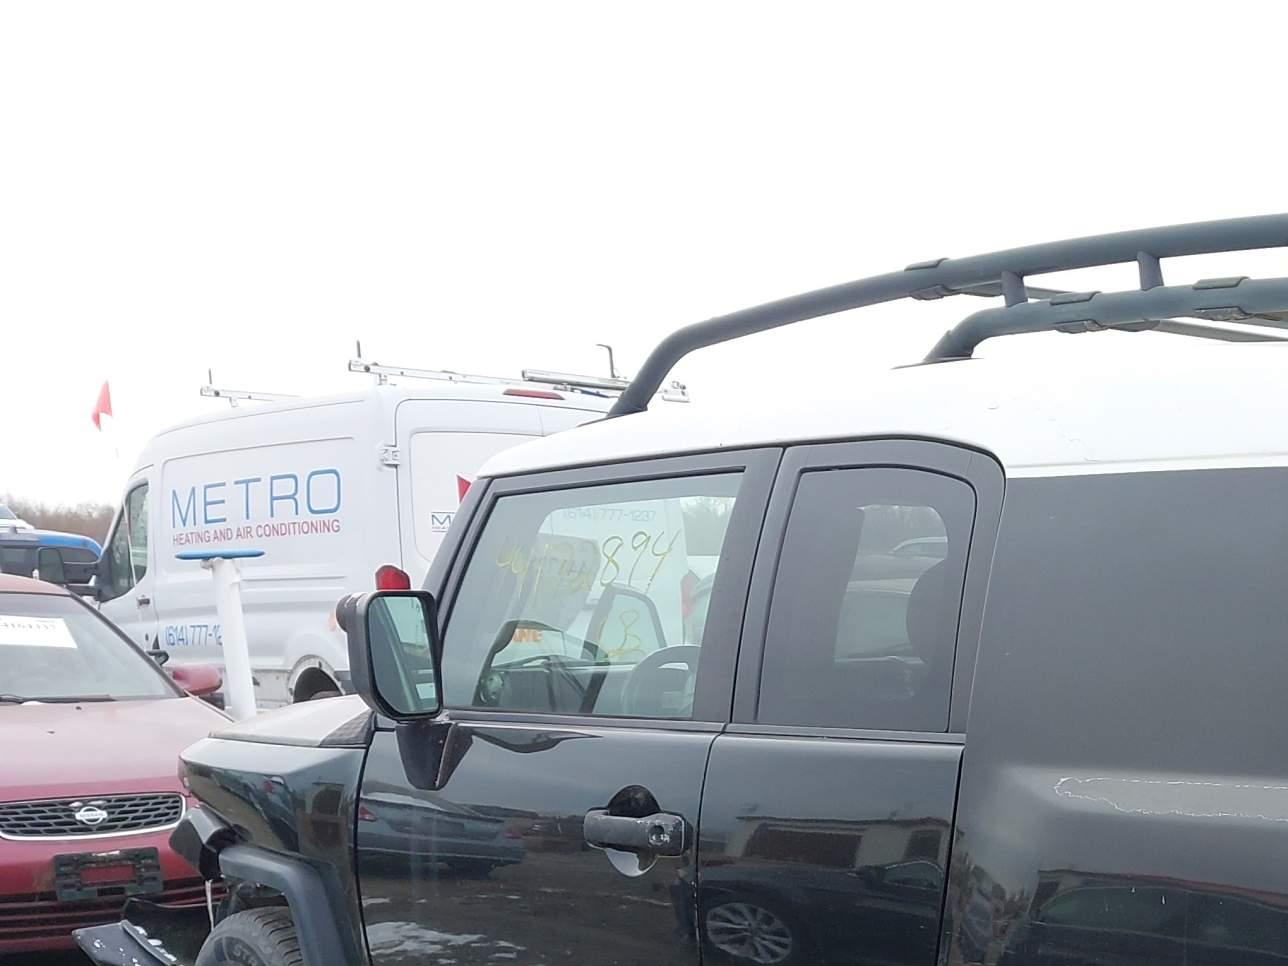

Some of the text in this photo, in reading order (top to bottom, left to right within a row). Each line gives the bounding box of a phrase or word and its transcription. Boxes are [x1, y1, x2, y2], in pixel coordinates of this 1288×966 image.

[171, 468, 341, 529] METRO
[172, 519, 341, 546] HEATING AND AIR CONDITIONING
